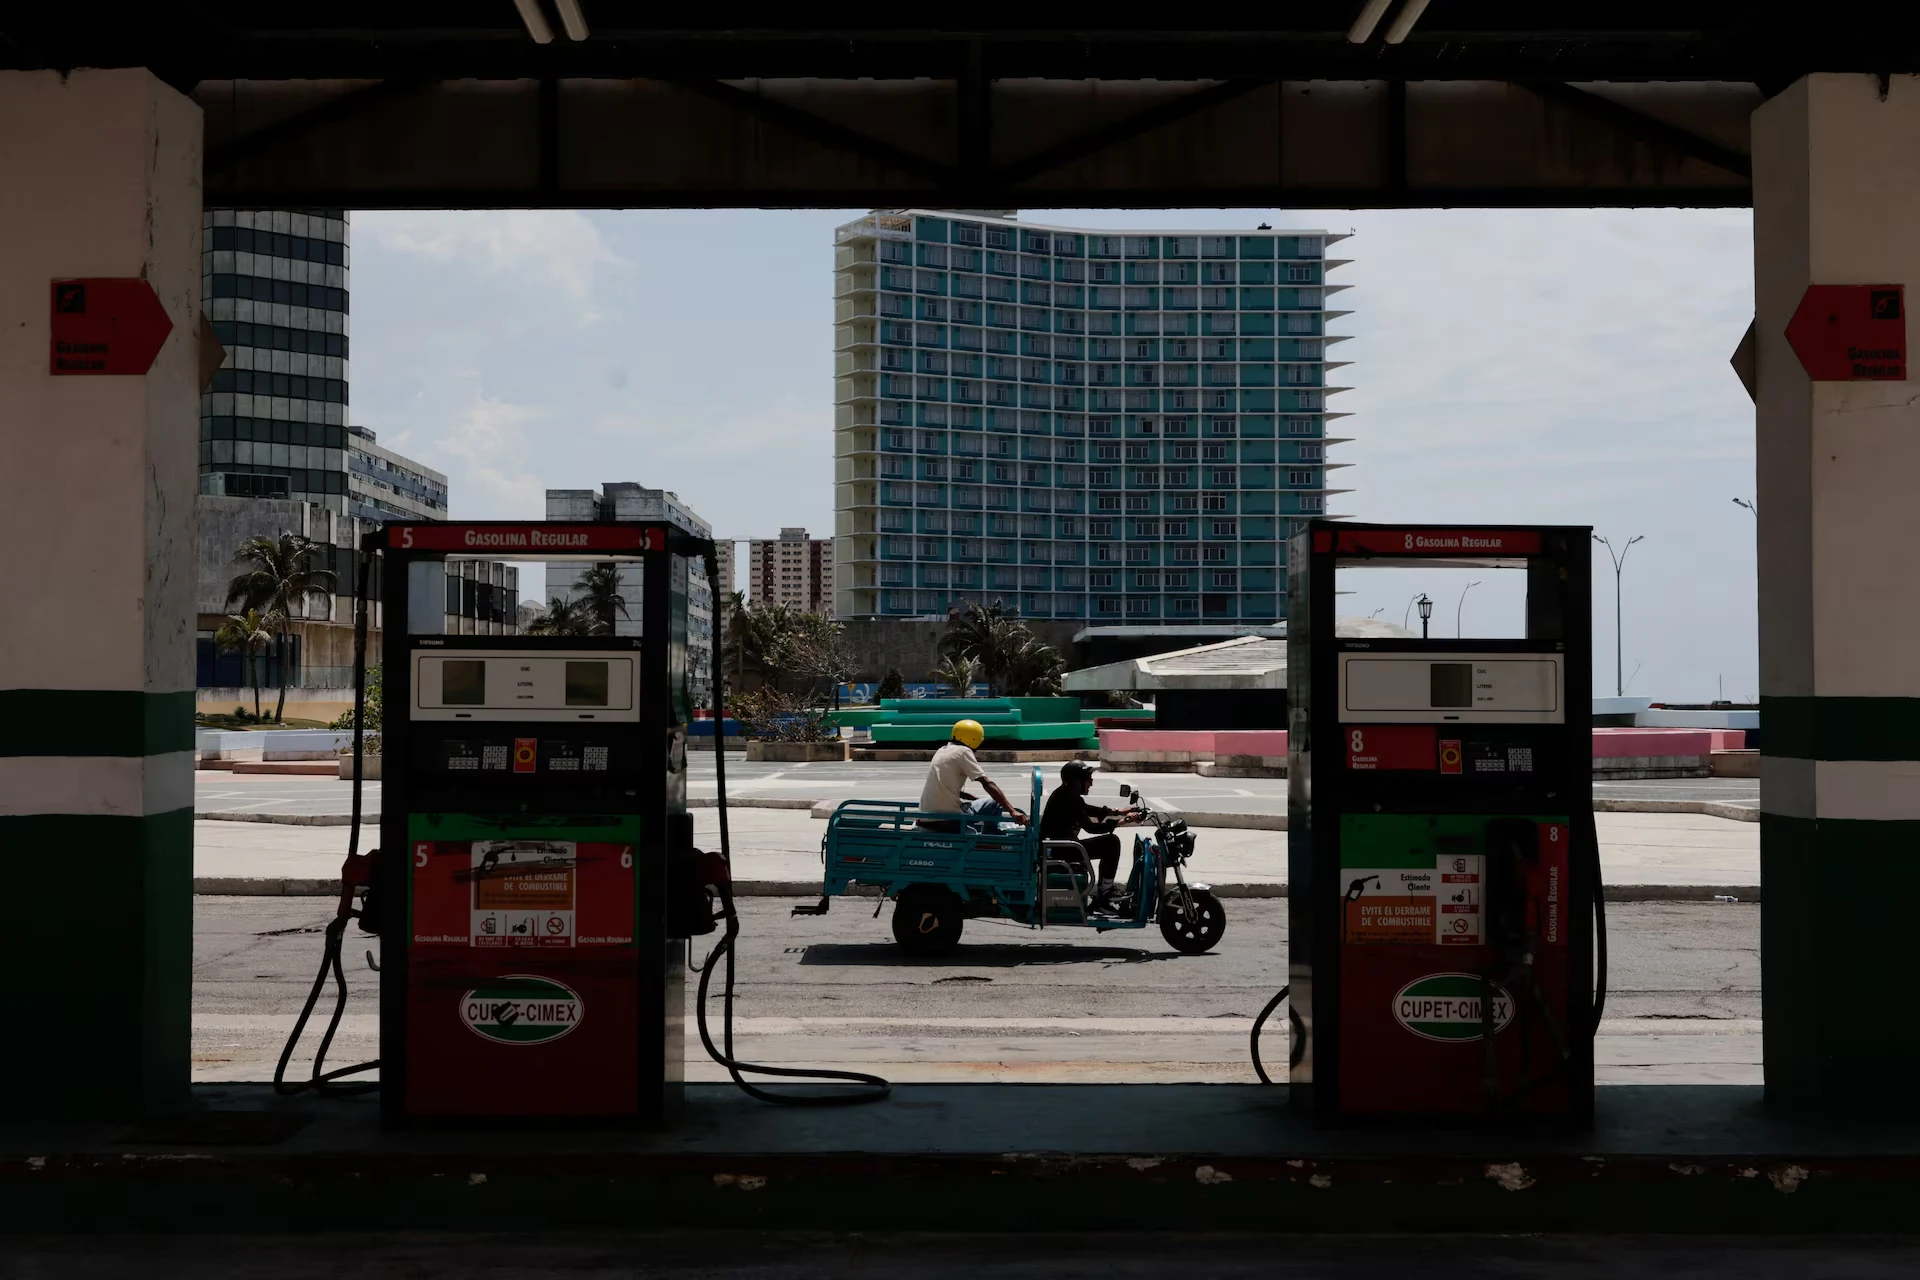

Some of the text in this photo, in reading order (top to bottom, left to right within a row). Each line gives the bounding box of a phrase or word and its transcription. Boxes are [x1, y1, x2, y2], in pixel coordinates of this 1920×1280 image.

[401, 527, 414, 549] 5
[1404, 533, 1414, 549] 8
[1351, 729, 1363, 752] 8
[1549, 826, 1559, 842] 8
[415, 844, 428, 867] 5
[619, 846, 633, 868] 6
[1400, 873, 1431, 881] Estimado
[503, 882, 568, 891] DE COMBUSTIBLE
[1407, 883, 1431, 891] Cliente
[1361, 906, 1431, 915] EVITE EL DERRAME
[1361, 917, 1432, 926] DE COMBUSTIBLE
